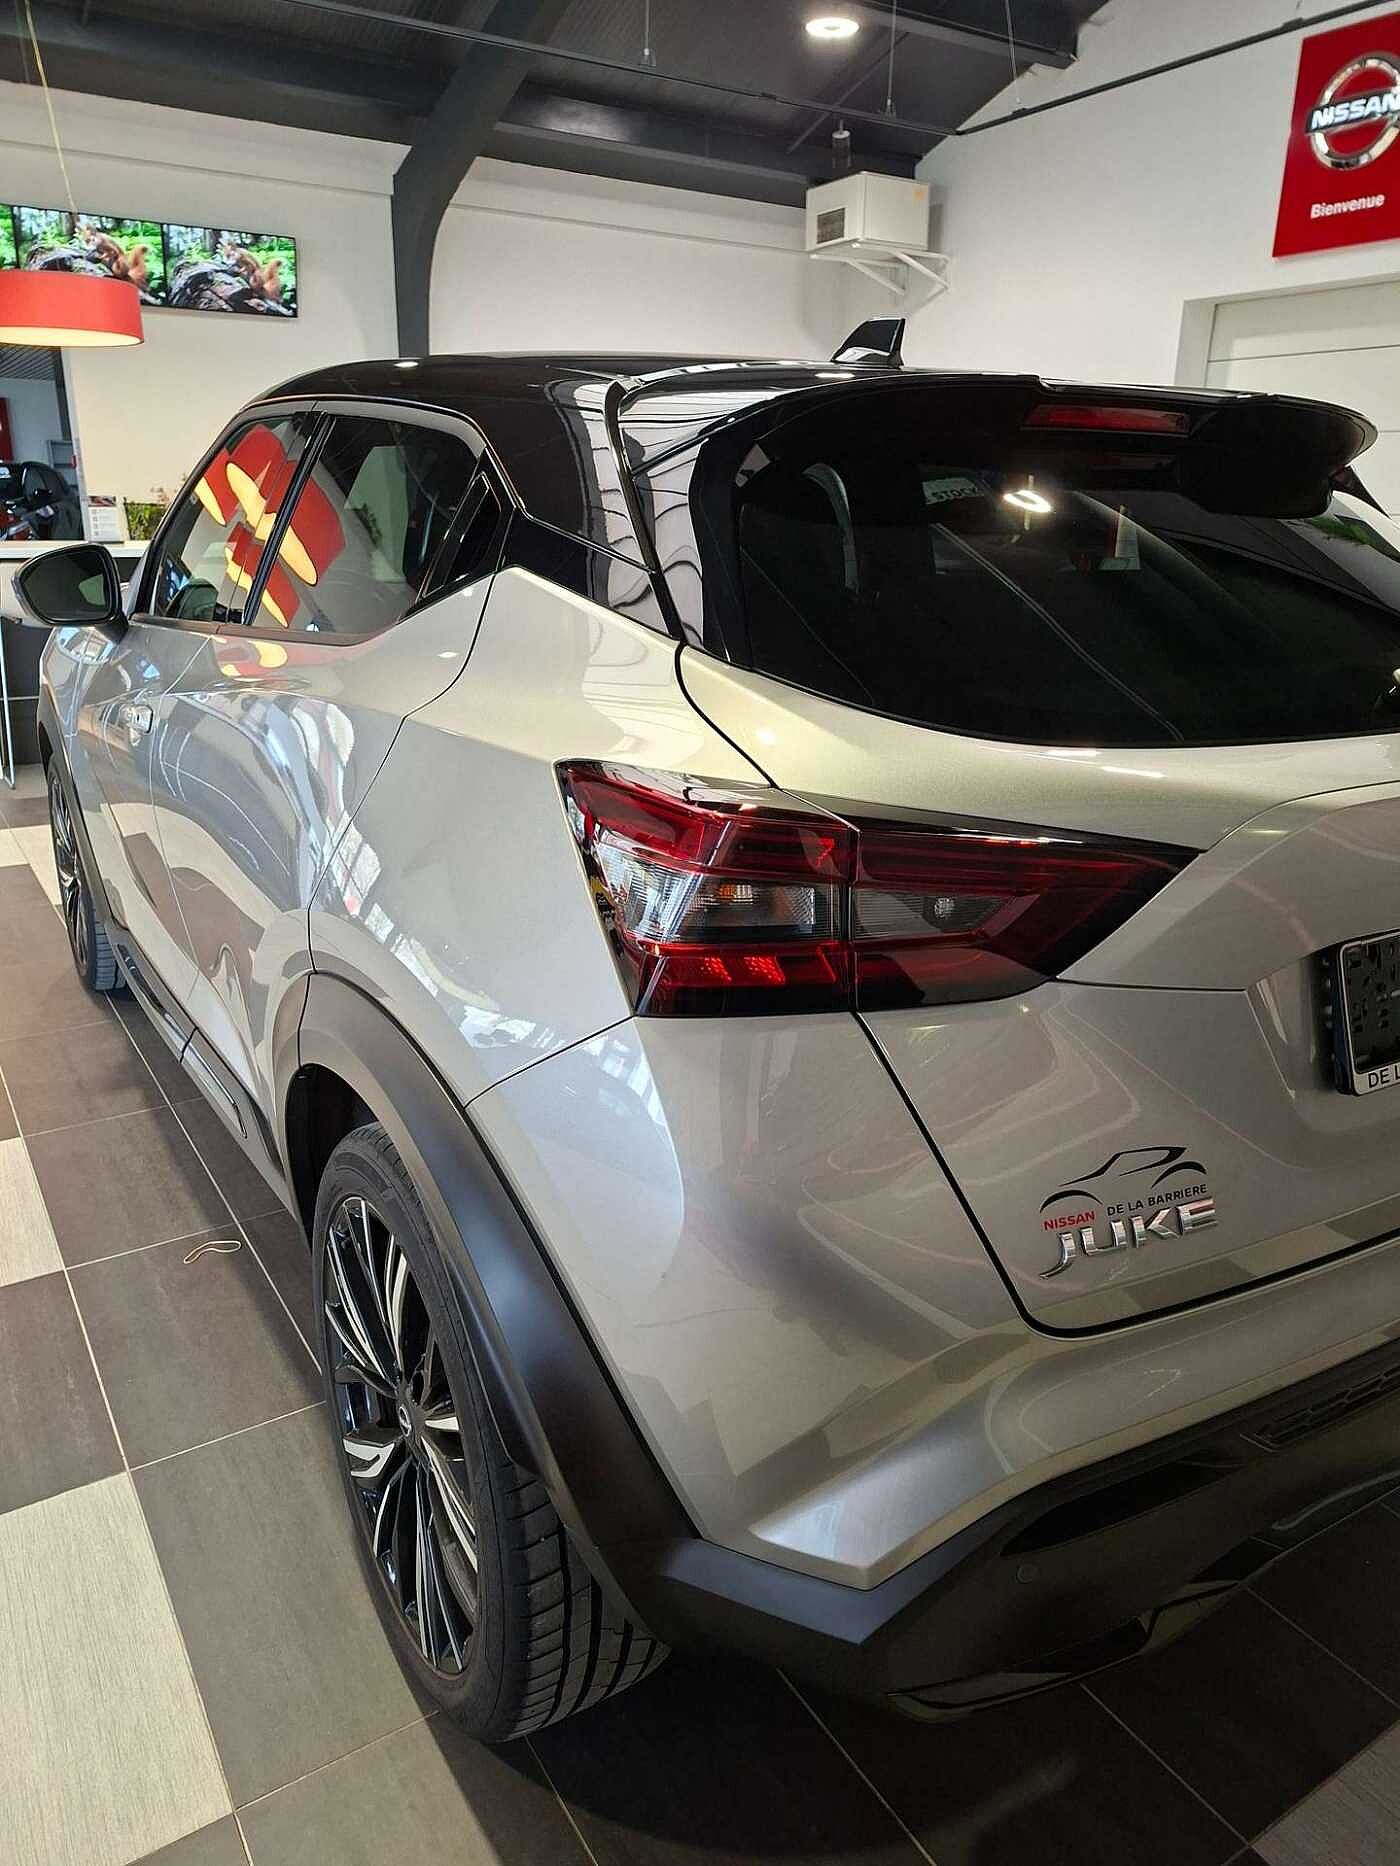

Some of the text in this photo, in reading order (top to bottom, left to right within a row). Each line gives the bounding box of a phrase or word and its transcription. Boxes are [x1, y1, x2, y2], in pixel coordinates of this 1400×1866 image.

[1311, 92, 1400, 127] NISSAN
[1310, 194, 1386, 219] Bienvenue
[1368, 1067, 1390, 1088] DE
[1107, 1184, 1208, 1216] DE LA BARRIERE
[1043, 1210, 1096, 1231] NISSAN
[1039, 1196, 1219, 1280] JUKE
